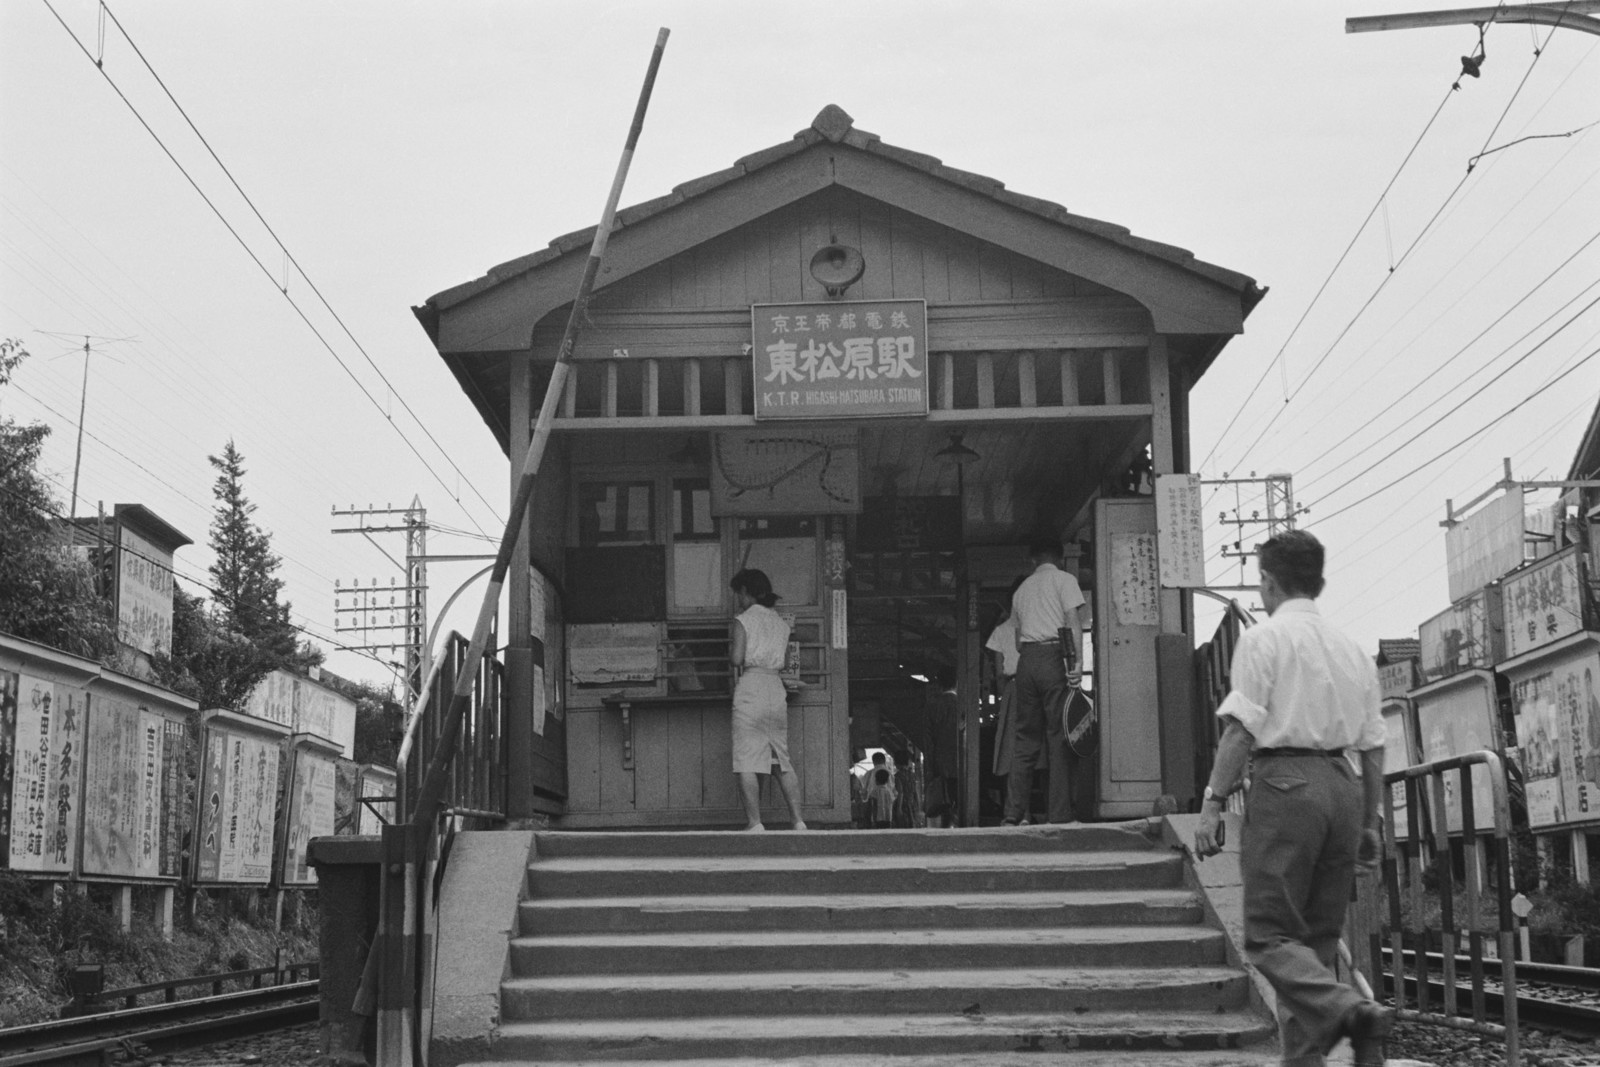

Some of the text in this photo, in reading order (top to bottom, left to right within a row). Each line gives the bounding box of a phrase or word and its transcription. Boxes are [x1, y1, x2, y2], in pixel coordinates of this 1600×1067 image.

[770, 310, 911, 335] 京王帝都電鉄
[763, 336, 922, 386] 東松原駅
[763, 391, 804, 407] K.T.R.
[888, 387, 922, 403] STATION
